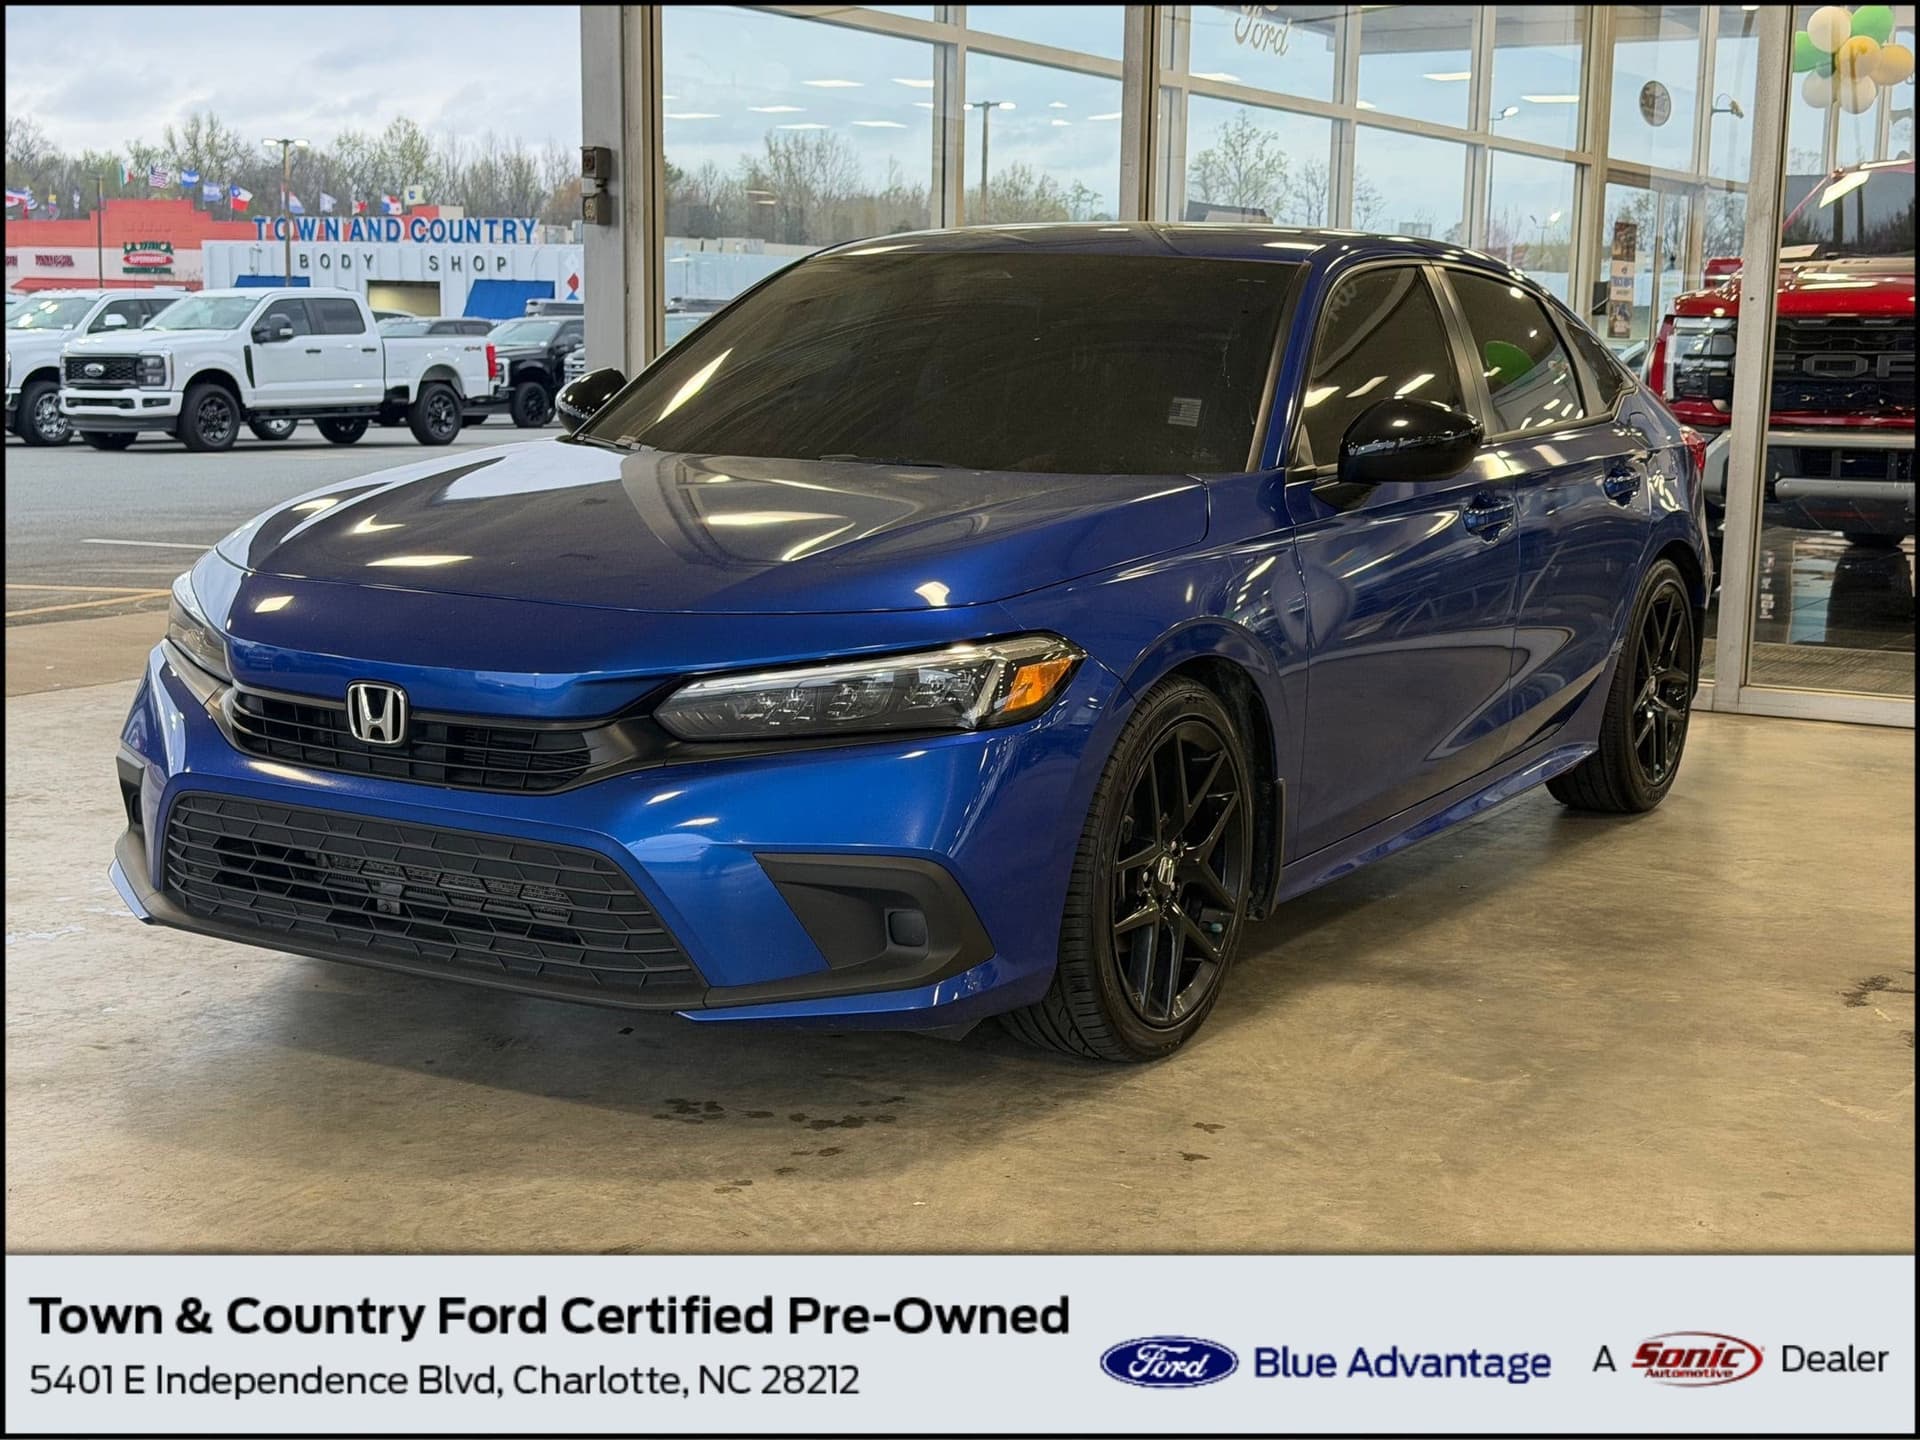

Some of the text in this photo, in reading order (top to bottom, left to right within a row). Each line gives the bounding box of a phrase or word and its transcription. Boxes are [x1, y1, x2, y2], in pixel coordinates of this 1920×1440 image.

[252, 216, 539, 245] TOWN AND COUNTRY
[299, 253, 508, 273] BODY SHOP
